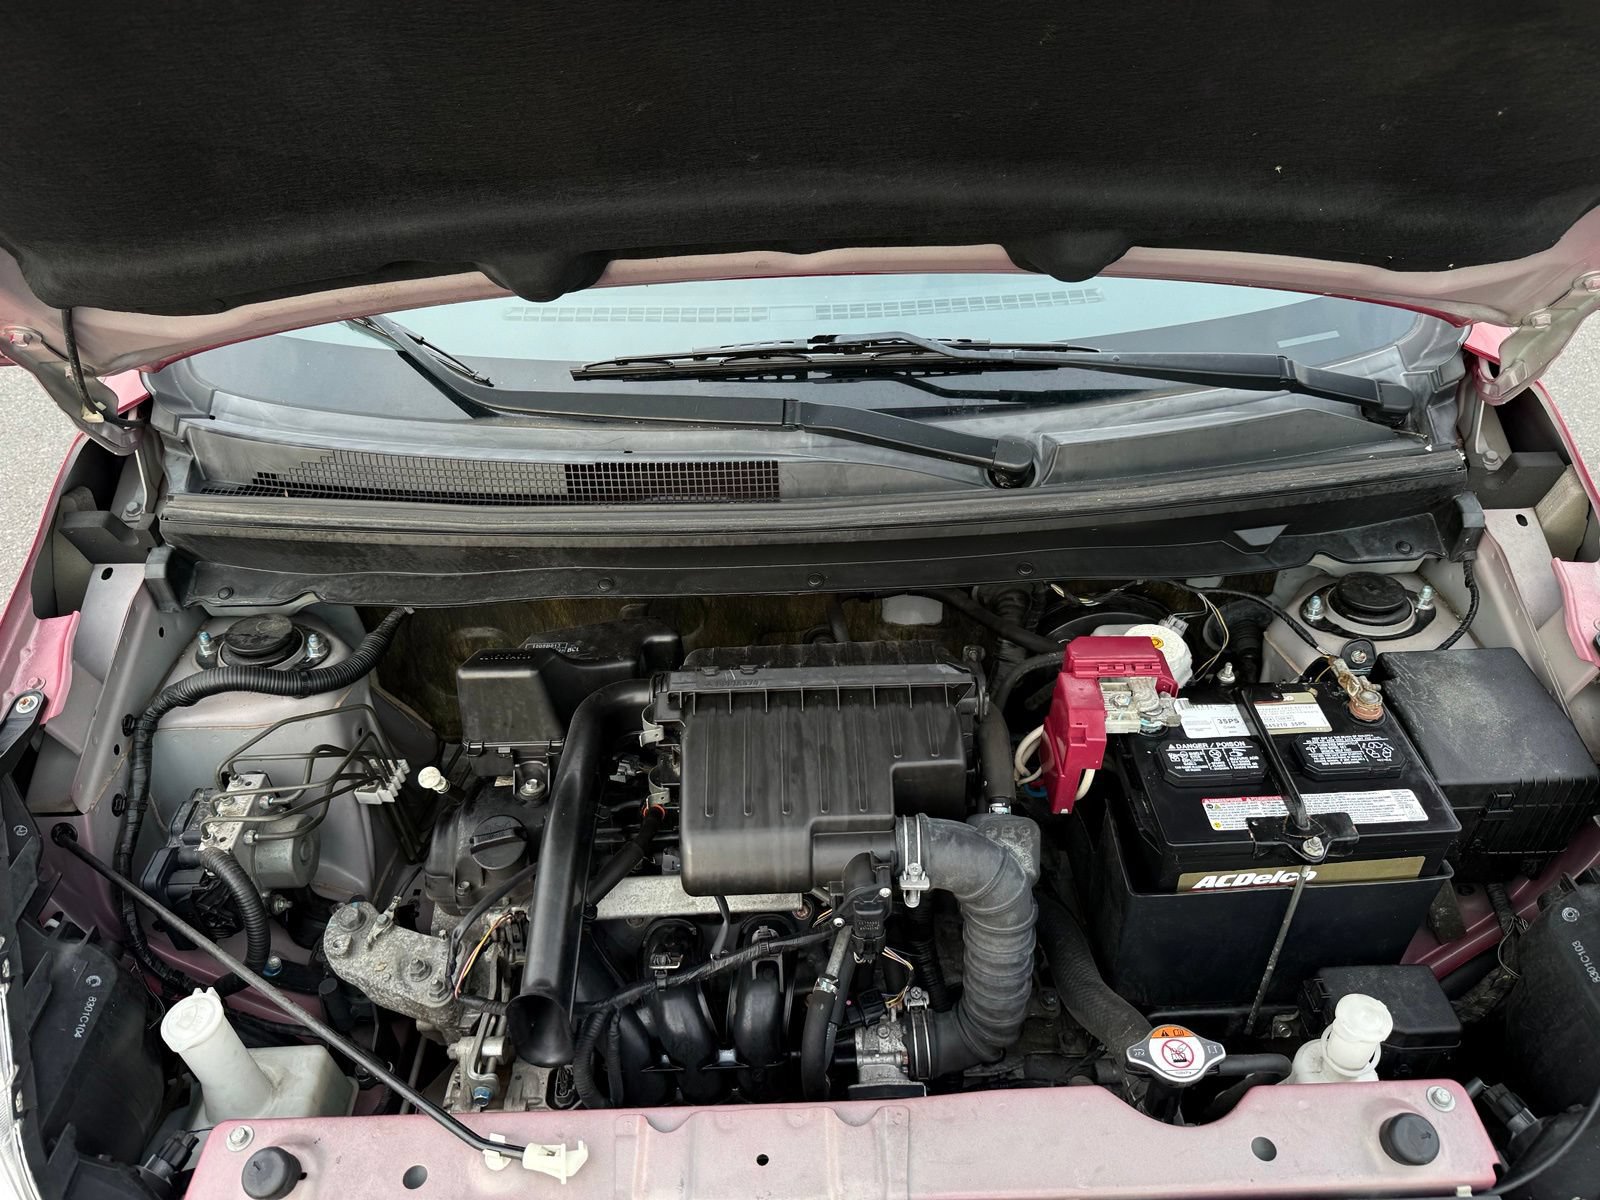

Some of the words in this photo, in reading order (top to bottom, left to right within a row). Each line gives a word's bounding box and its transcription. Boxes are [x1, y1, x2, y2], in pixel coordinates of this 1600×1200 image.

[1175, 742, 1209, 750] DANGER
[1215, 740, 1246, 748] POISON
[73, 996, 97, 1038] 8301C104
